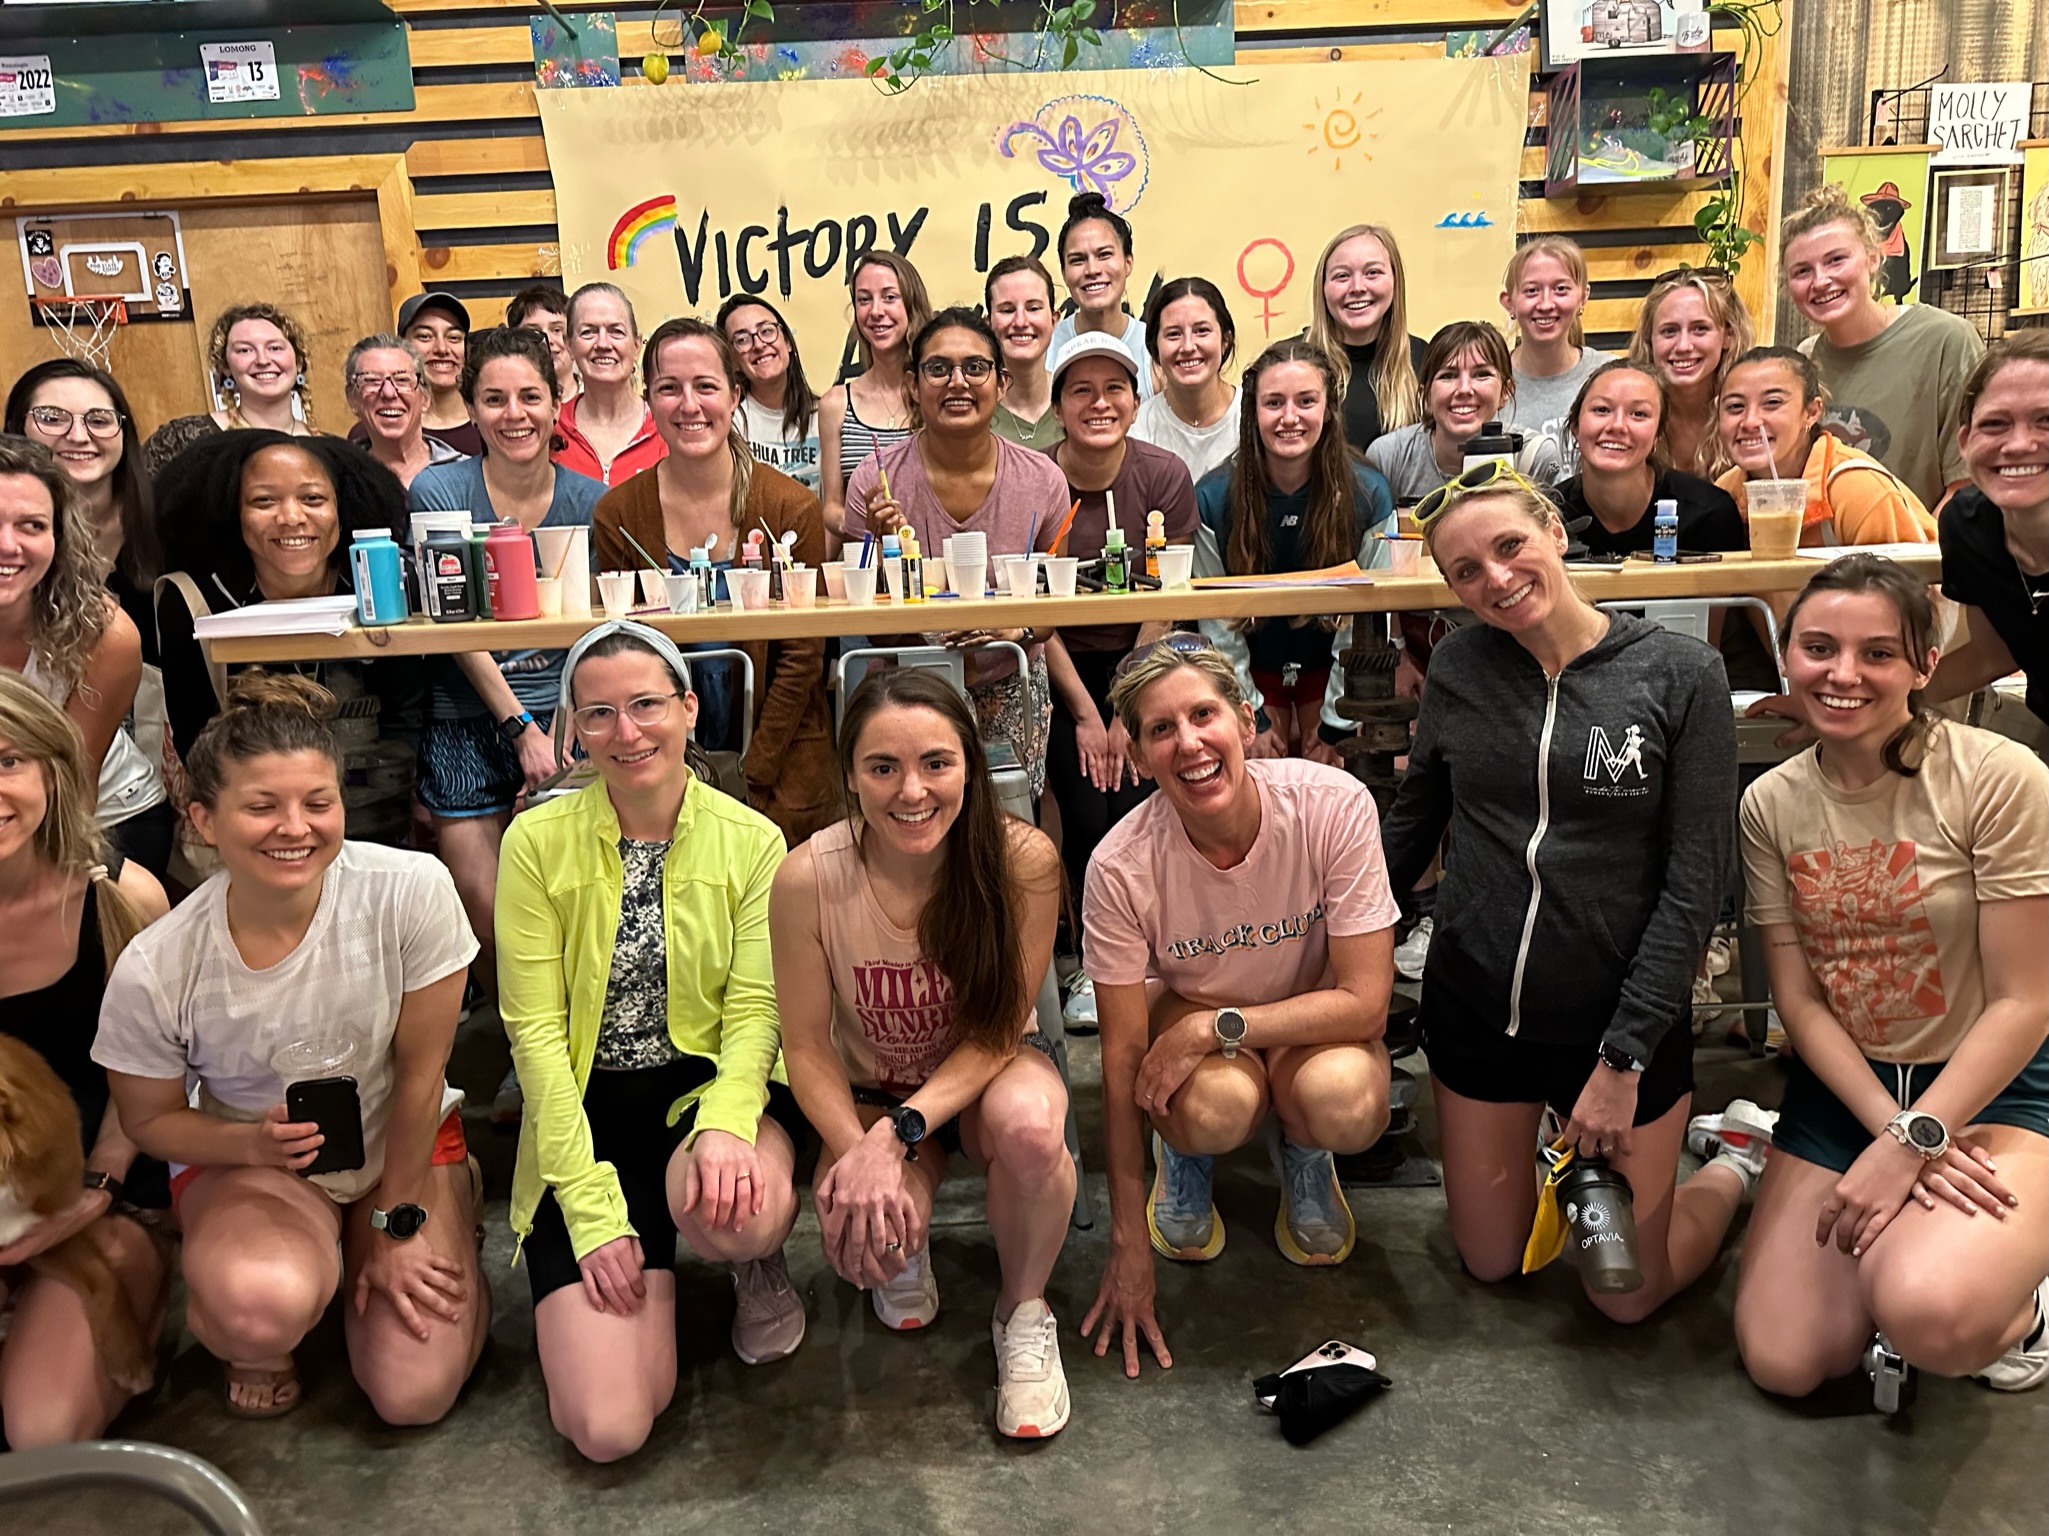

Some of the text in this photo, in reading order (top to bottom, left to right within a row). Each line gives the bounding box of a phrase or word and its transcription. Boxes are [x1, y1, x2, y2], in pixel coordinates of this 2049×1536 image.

[219, 44, 257, 54] LOMONG
[17, 69, 51, 90] 2022
[247, 61, 264, 82] 13
[1938, 90, 2008, 122] MOLLY
[1933, 119, 2022, 151] SARCHET
[974, 190, 1050, 273] IS
[782, 446, 817, 466] TREE
[1167, 924, 1261, 960] TRACK
[1581, 1231, 1621, 1250] OPTAVIA
